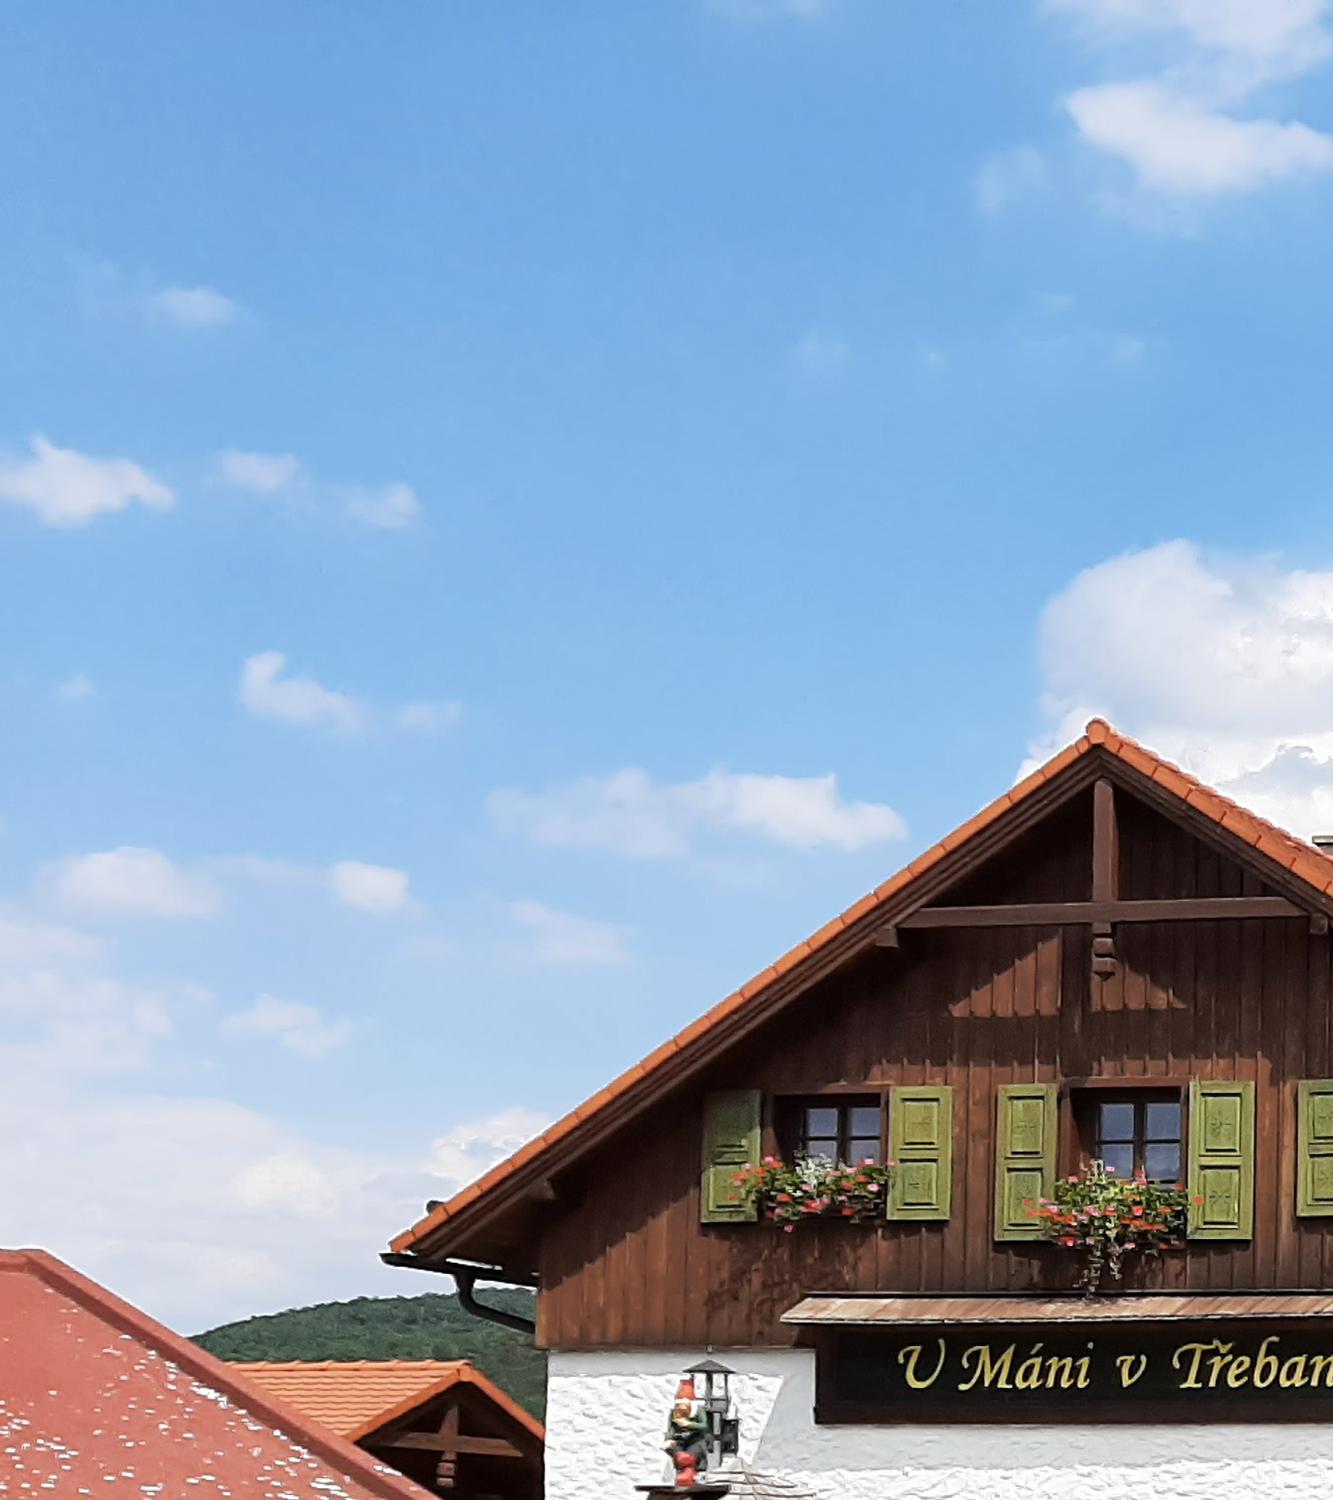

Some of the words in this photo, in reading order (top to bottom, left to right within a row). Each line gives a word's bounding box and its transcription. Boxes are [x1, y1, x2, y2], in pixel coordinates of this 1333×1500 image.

[898, 1338, 946, 1389] U
[958, 1341, 1094, 1391] Máni
[1116, 1354, 1147, 1388] v
